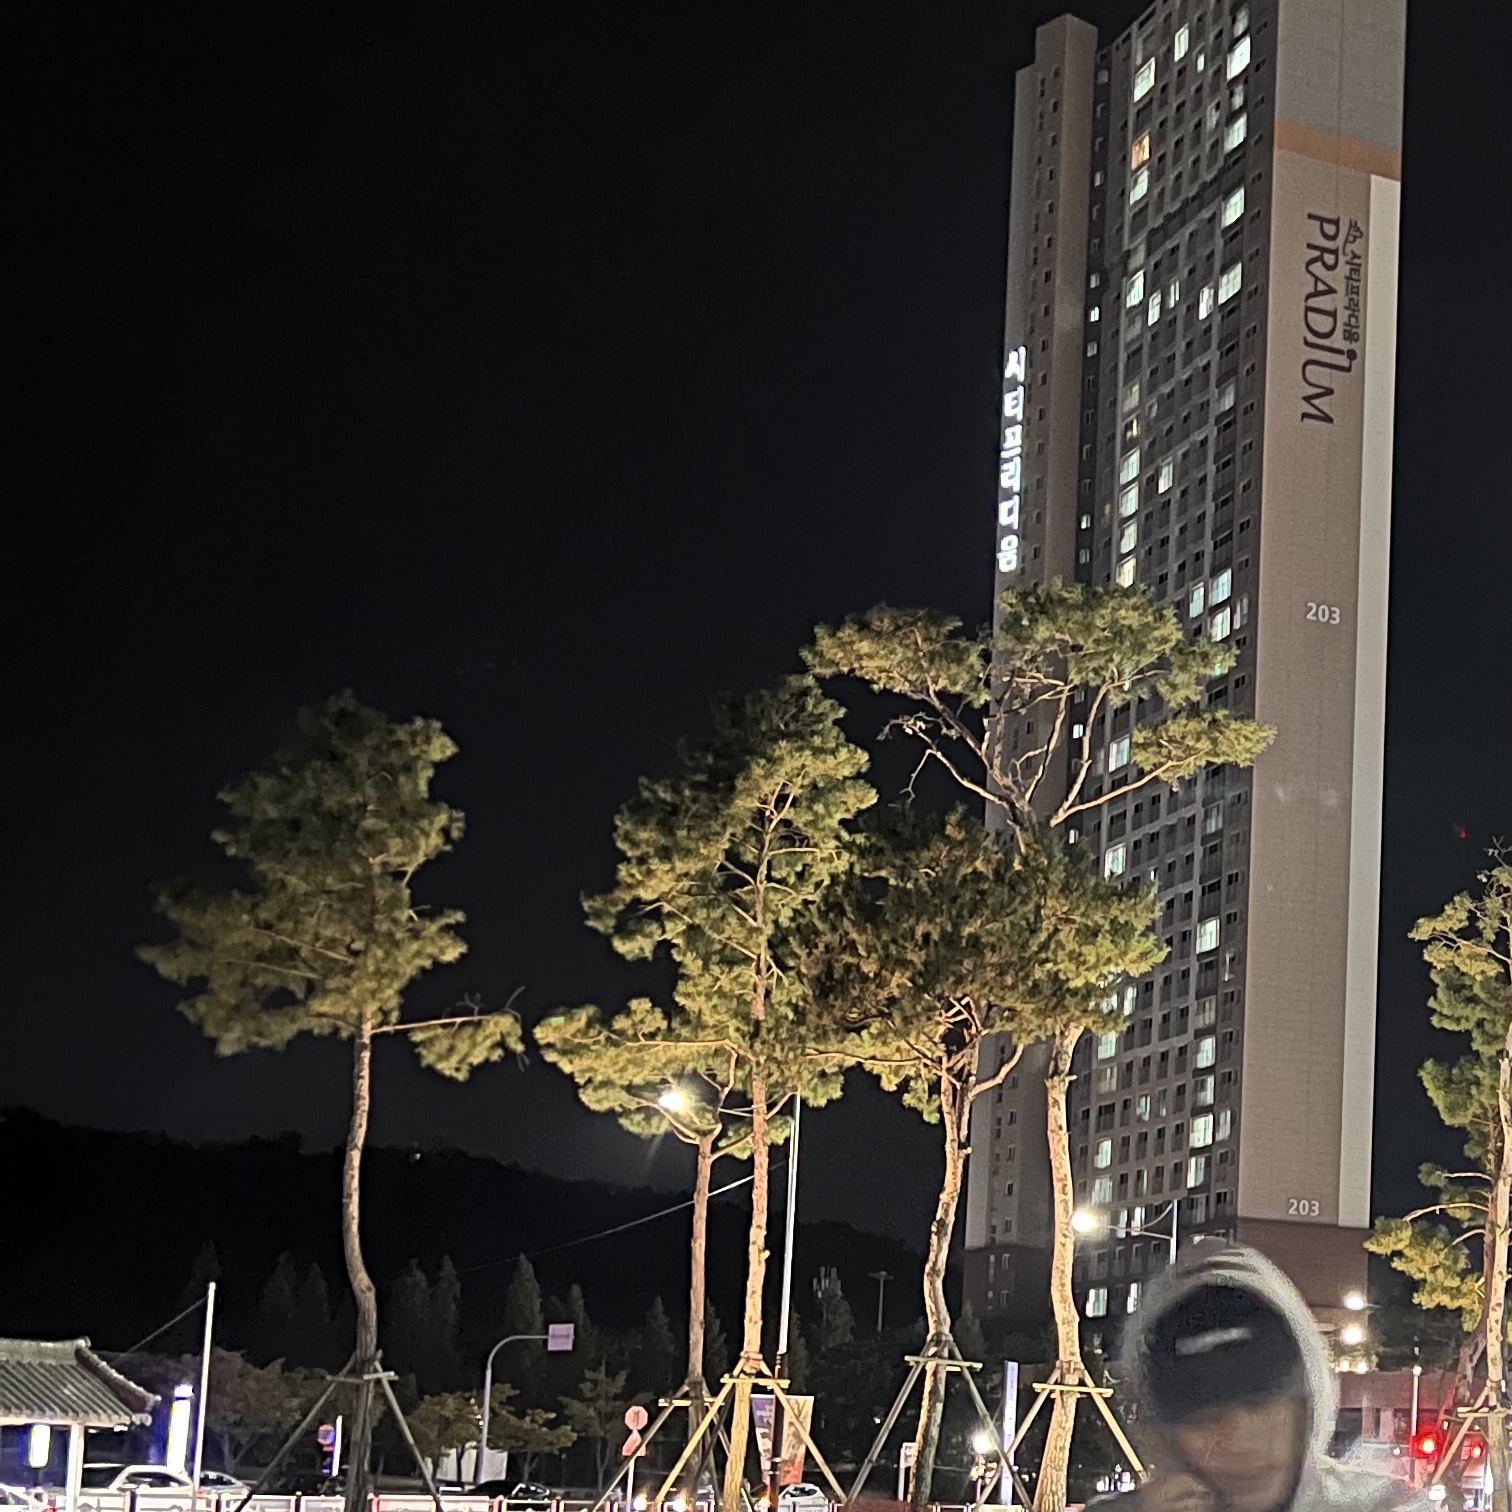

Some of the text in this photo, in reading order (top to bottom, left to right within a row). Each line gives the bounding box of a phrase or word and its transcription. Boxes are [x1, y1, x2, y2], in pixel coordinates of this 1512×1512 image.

[1300, 212, 1358, 425] PRADIUM
[1342, 251, 1362, 345] 시티프라디움
[995, 345, 1027, 573] 시티프라디움
[1305, 602, 1341, 625] 203
[1288, 1198, 1319, 1216] 203
